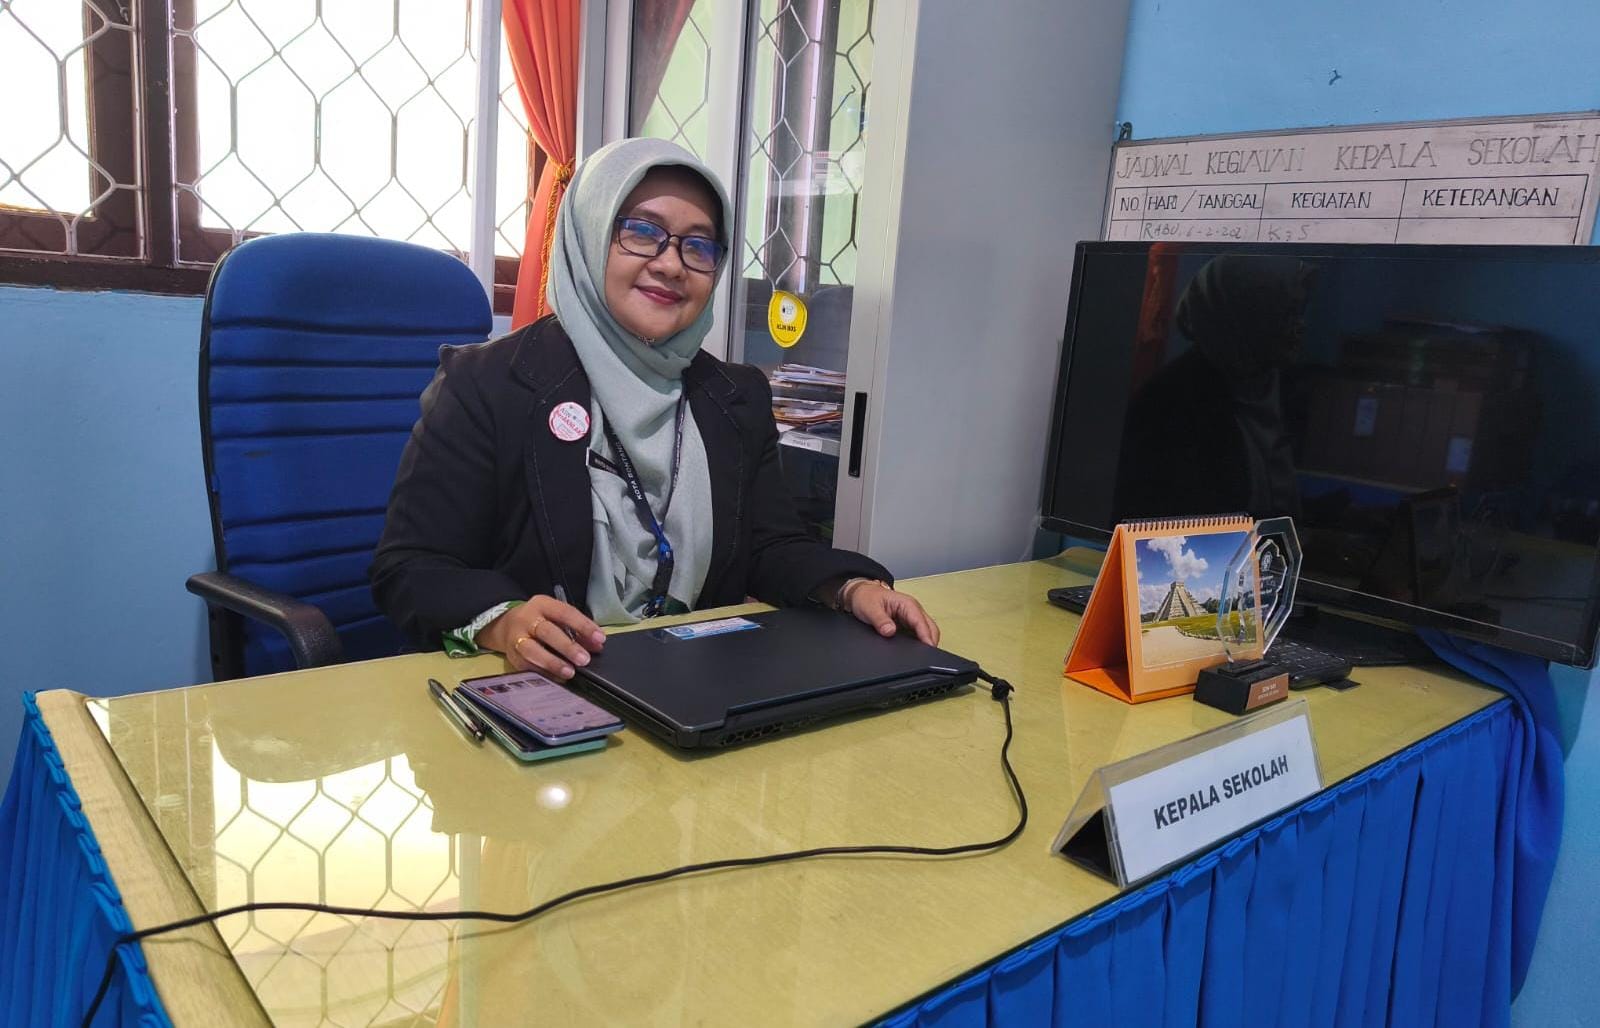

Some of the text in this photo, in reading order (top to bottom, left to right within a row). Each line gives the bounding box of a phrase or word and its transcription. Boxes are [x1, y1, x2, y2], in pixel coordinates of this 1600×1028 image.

[1117, 153, 1192, 178] JADWAL
[1334, 141, 1437, 171] KEPALA
[1467, 134, 1600, 165] SEKOLAH
[1148, 194, 1178, 210] HARI
[1198, 193, 1262, 209] TANGGAL
[1291, 191, 1372, 209] KEGIATAN
[1422, 187, 1560, 207] KETERANGAN
[630, 480, 643, 500] KOTA
[1153, 754, 1289, 830] KEPALA SEKOLAH
